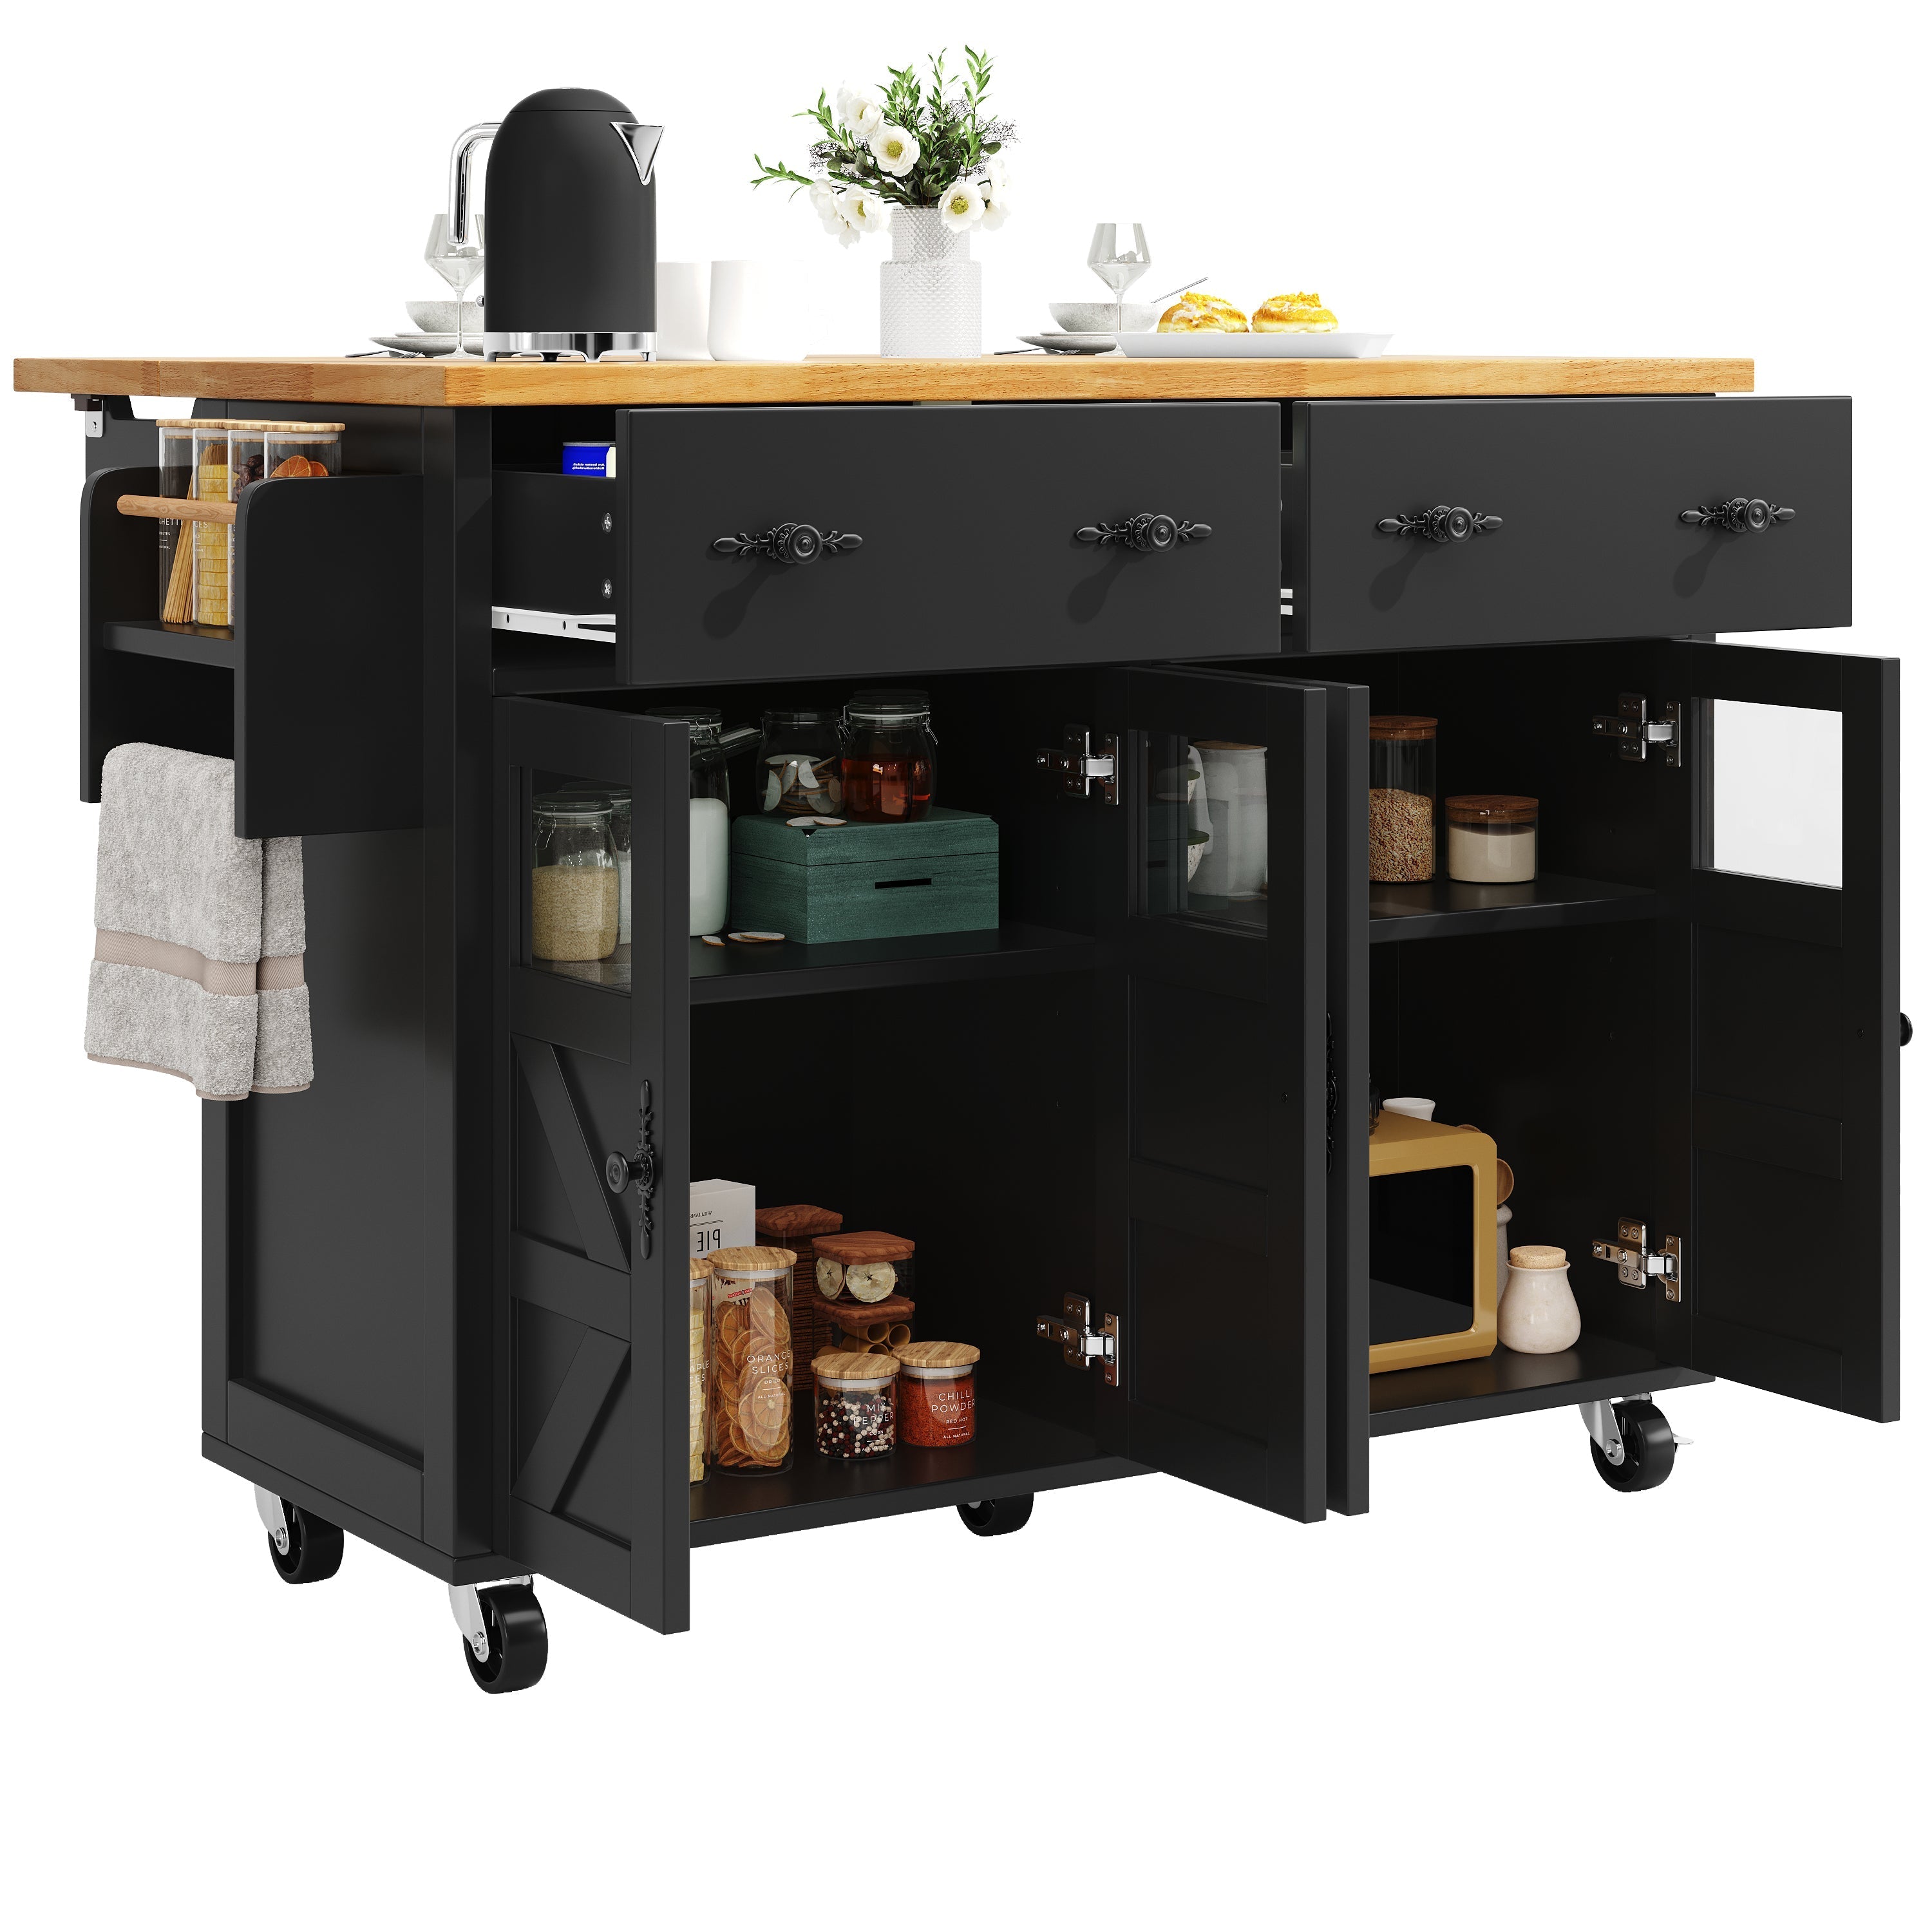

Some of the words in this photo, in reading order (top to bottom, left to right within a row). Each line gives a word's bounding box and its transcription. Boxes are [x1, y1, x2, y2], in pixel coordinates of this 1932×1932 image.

[747, 1350, 791, 1363] ORANGE
[752, 1362, 788, 1374] SLICES
[938, 1389, 972, 1401] CHILLI
[867, 1403, 886, 1412] MIX
[931, 1399, 975, 1413] POWDER
[853, 1412, 893, 1425] PEPPER
